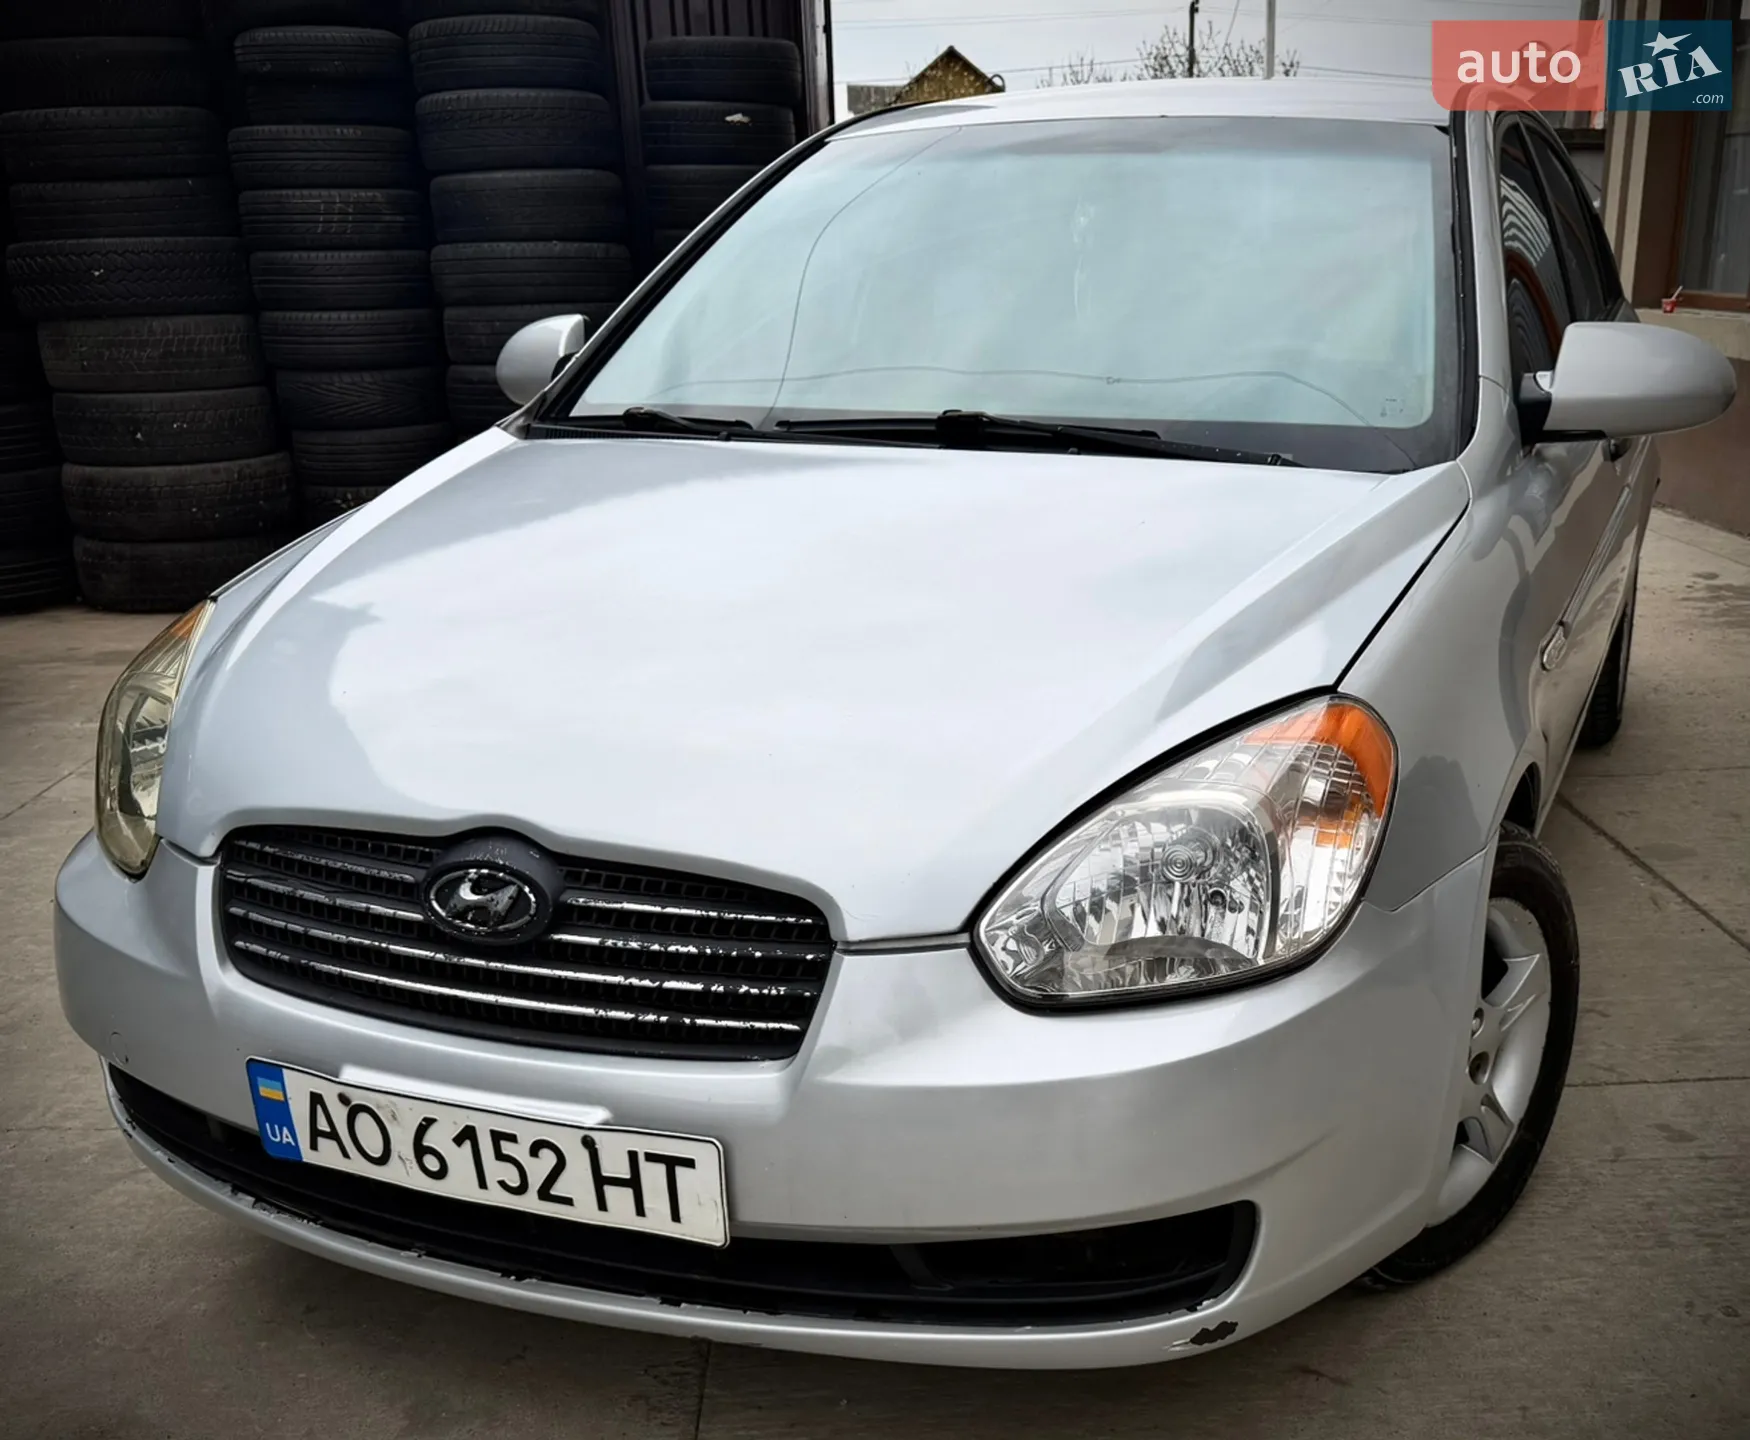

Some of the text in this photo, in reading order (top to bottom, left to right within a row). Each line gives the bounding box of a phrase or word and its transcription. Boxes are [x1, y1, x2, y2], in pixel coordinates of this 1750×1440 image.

[266, 1123, 296, 1147] UA
[308, 1091, 697, 1223] AO 6152 HT
